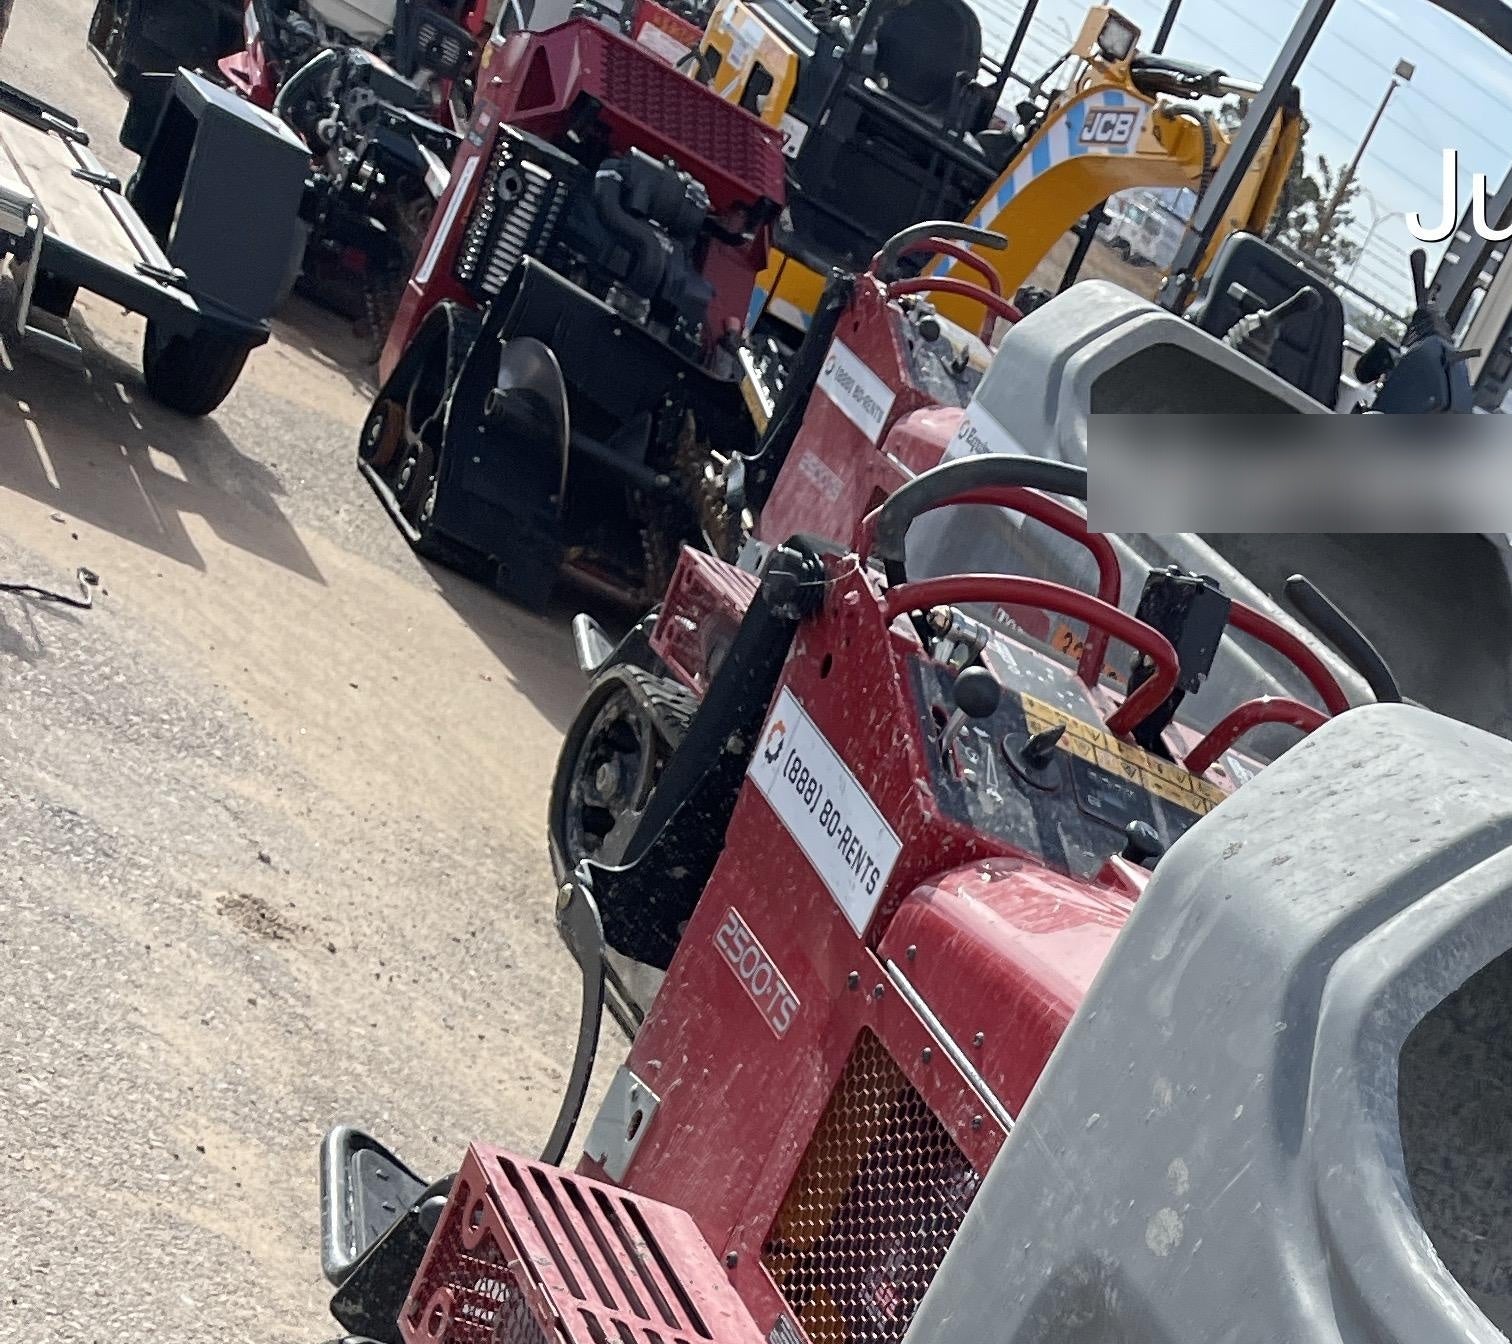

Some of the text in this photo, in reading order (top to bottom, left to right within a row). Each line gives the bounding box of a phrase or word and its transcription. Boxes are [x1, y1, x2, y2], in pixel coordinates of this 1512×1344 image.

[1081, 112, 1135, 142] JCB
[784, 747, 881, 896] (888) 80-RENTS
